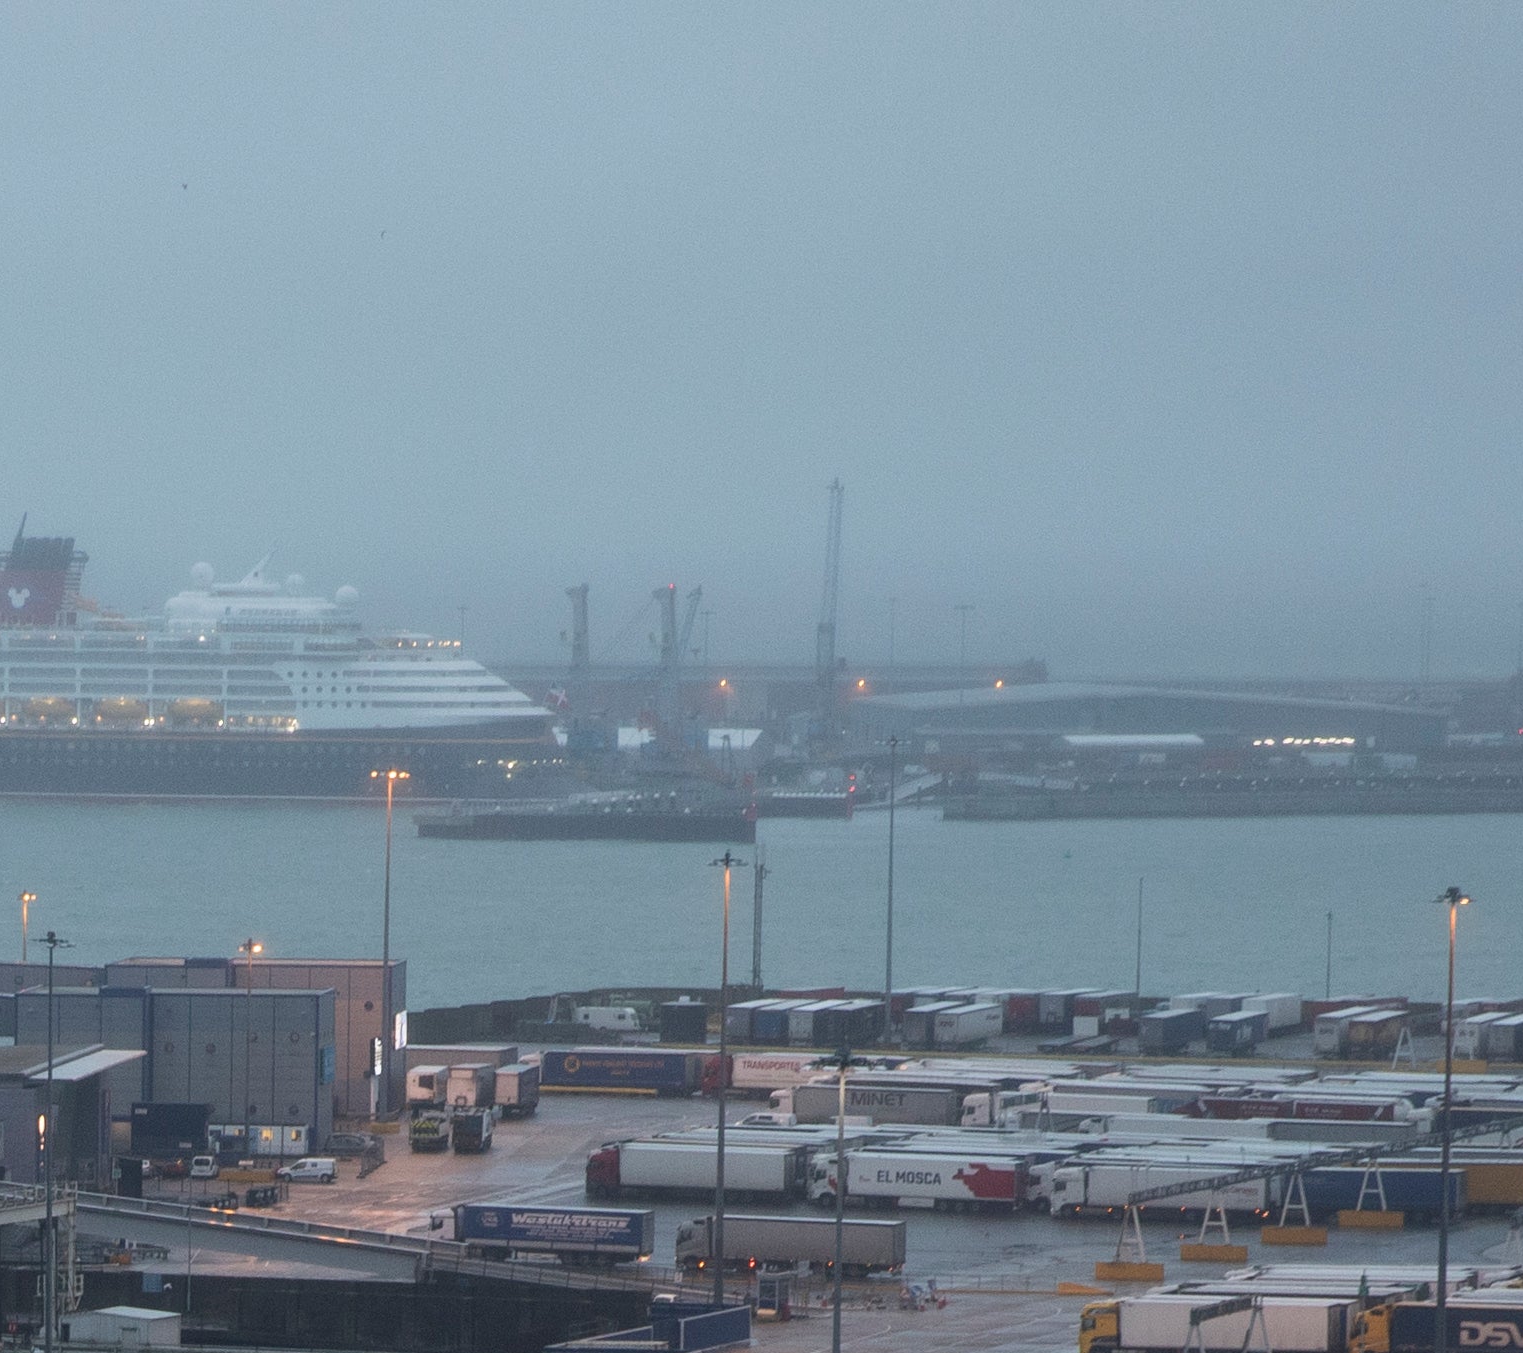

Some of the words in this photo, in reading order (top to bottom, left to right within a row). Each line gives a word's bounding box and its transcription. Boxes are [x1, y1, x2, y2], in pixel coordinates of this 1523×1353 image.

[850, 1090, 907, 1107] MINET
[876, 1170, 892, 1184] EL
[895, 1171, 942, 1185] MOSCA
